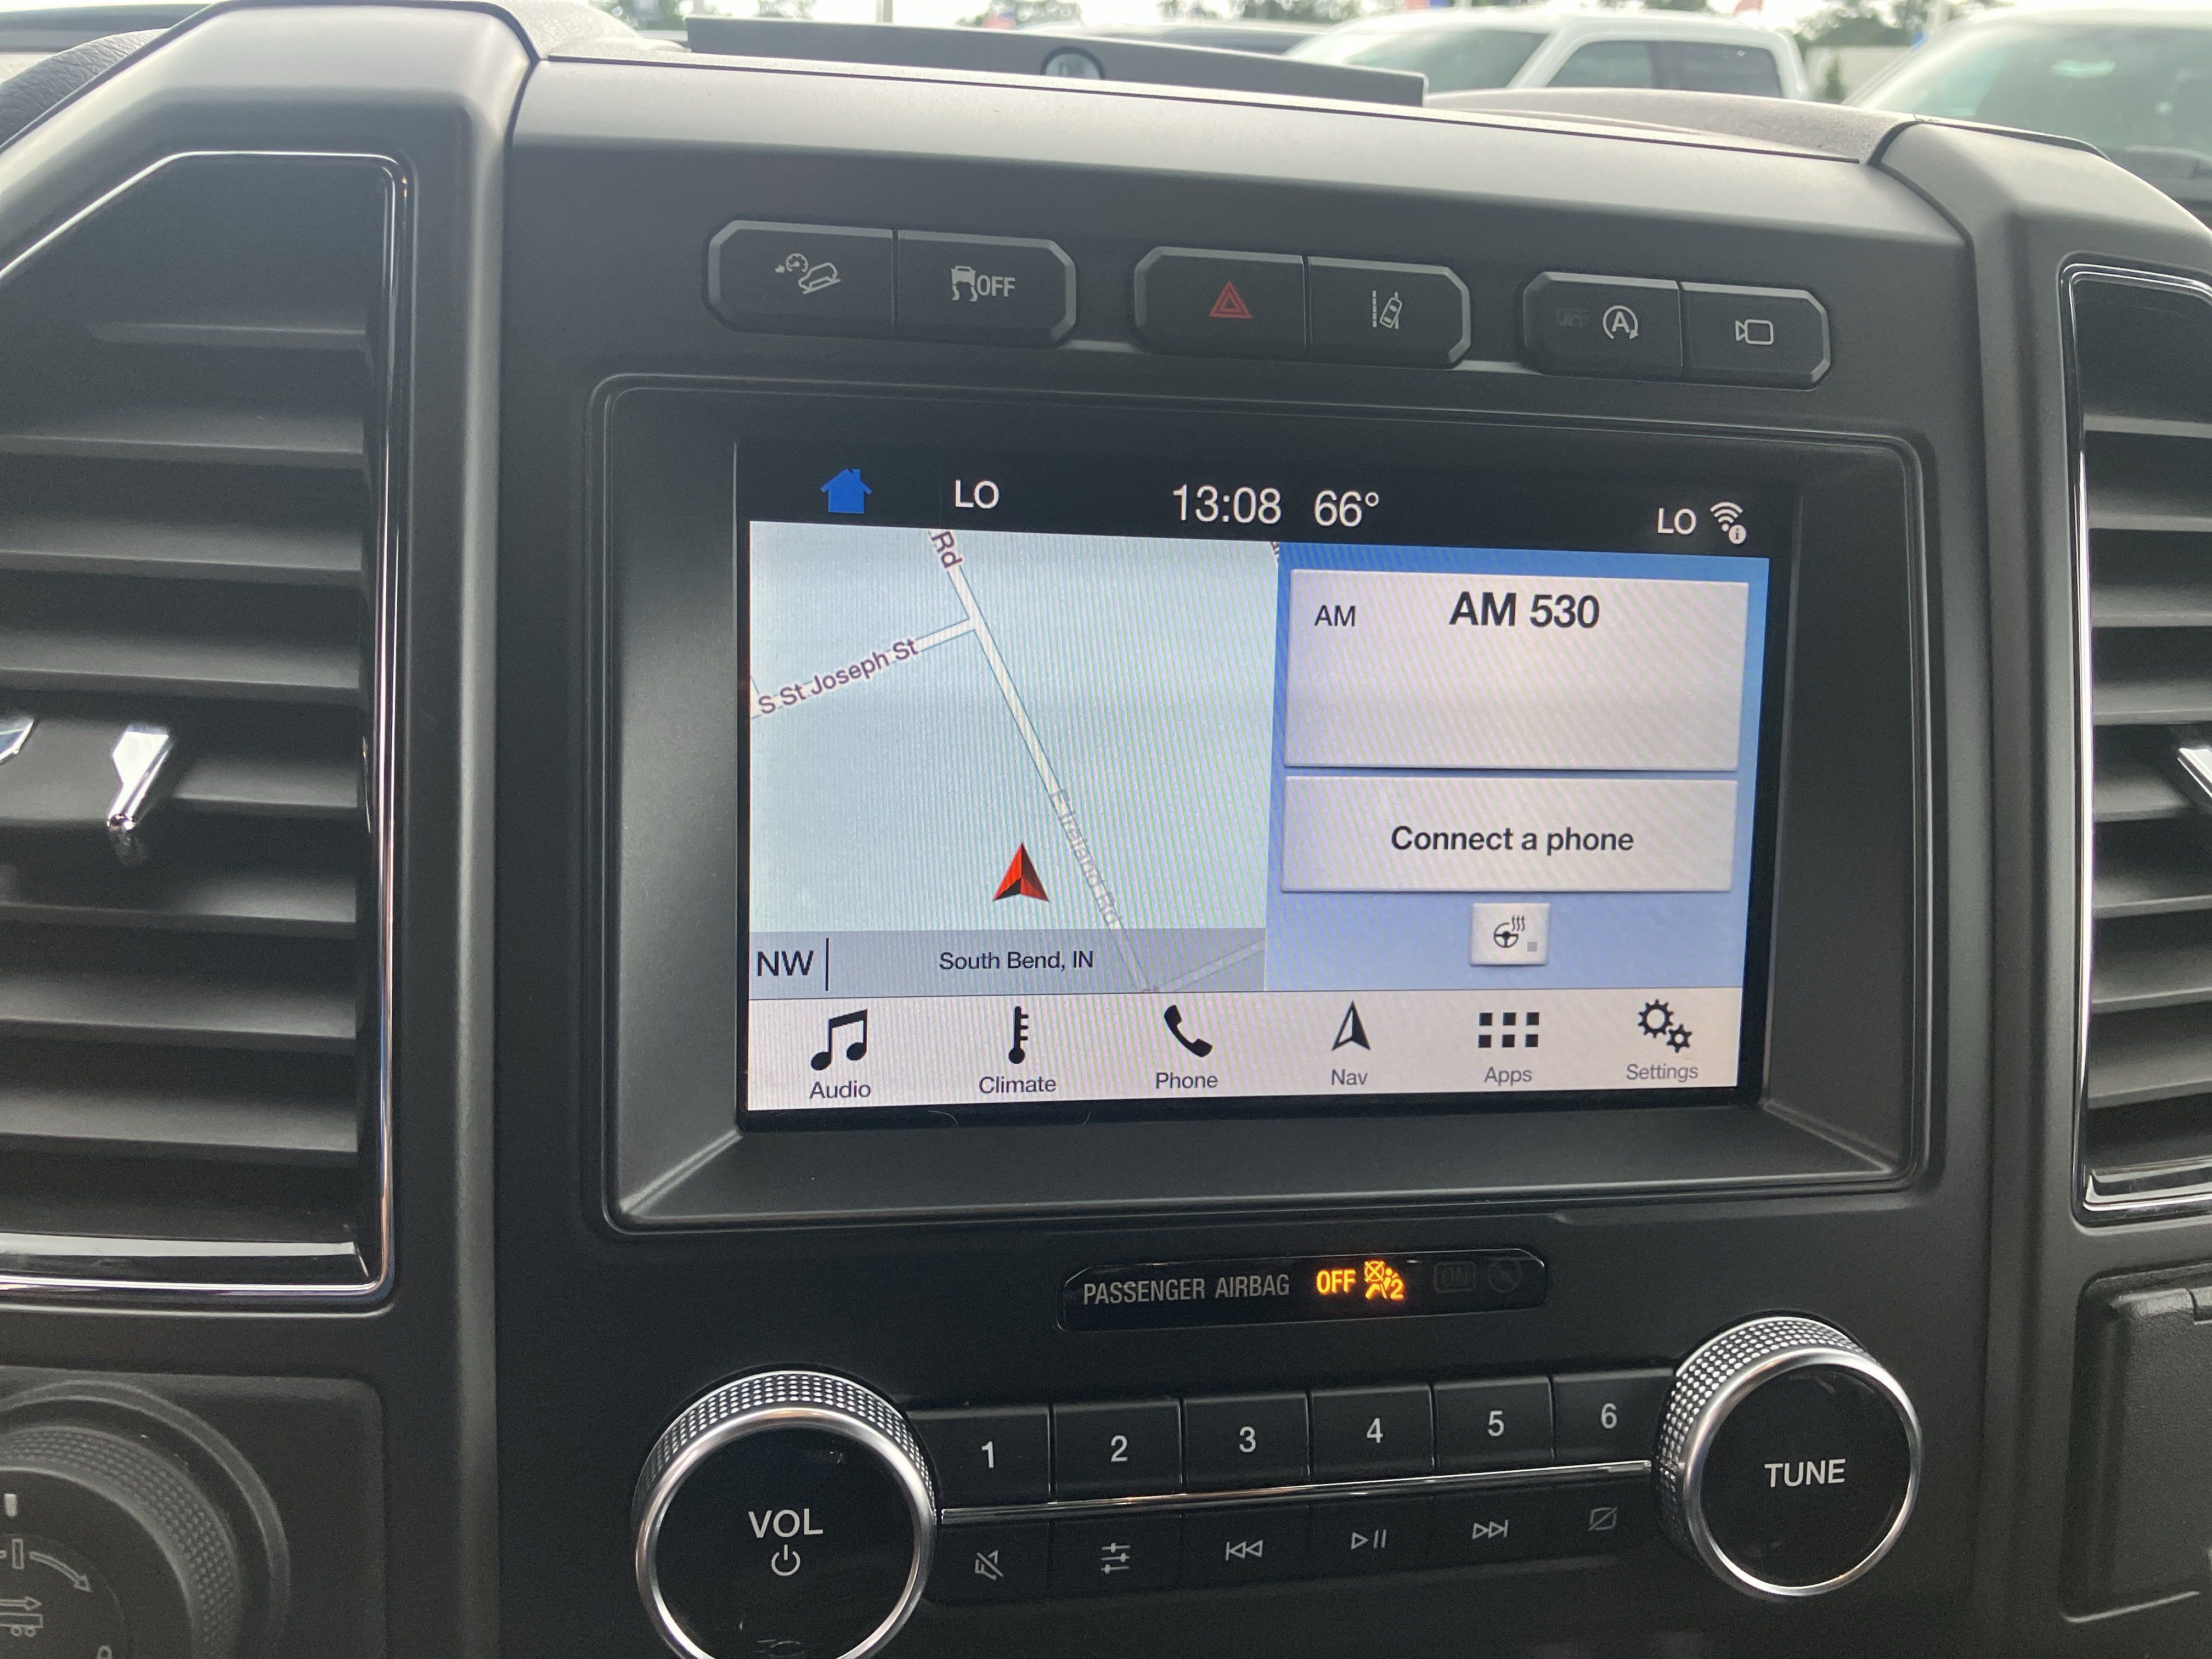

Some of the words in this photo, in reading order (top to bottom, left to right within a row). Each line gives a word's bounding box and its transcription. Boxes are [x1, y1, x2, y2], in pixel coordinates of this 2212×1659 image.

[977, 274, 1016, 297] OFF
[955, 479, 1000, 509] LO
[1172, 484, 1282, 524] 13:08
[1314, 489, 1380, 527] 66°
[1657, 507, 1697, 535] LO
[931, 531, 962, 568] Rd
[1313, 604, 1356, 627] AM
[1449, 590, 1517, 627] AM
[1530, 594, 1600, 629] 530
[758, 695, 776, 714] S
[780, 684, 806, 706] St
[810, 652, 889, 696] Joseph
[892, 637, 918, 661] St
[1391, 825, 1514, 851] Connect
[1521, 832, 1538, 851] a
[1546, 826, 1634, 857] phone
[757, 950, 815, 977] NW
[939, 951, 1001, 971] South
[1007, 950, 1066, 971] Bend,
[1072, 950, 1094, 968] IN
[978, 1075, 1057, 1095] Climate
[1155, 1071, 1219, 1090] Phone
[1330, 1068, 1368, 1086] Nav
[1483, 1065, 1533, 1087] Apps
[1625, 1062, 1699, 1084] Settings
[809, 1080, 872, 1099] Audio
[1083, 1277, 1205, 1305] PASSENGER
[1215, 1273, 1290, 1299] AIRBAG
[1316, 1268, 1357, 1295] OFF
[1487, 1410, 1505, 1437] 5
[1600, 1402, 1618, 1429] 6
[1239, 1425, 1257, 1453] 3
[1366, 1417, 1384, 1443] 4
[981, 1441, 994, 1469] 1
[1110, 1435, 1128, 1463] 2
[1764, 1458, 1846, 1488] TUNE
[748, 1508, 824, 1539] VOL
